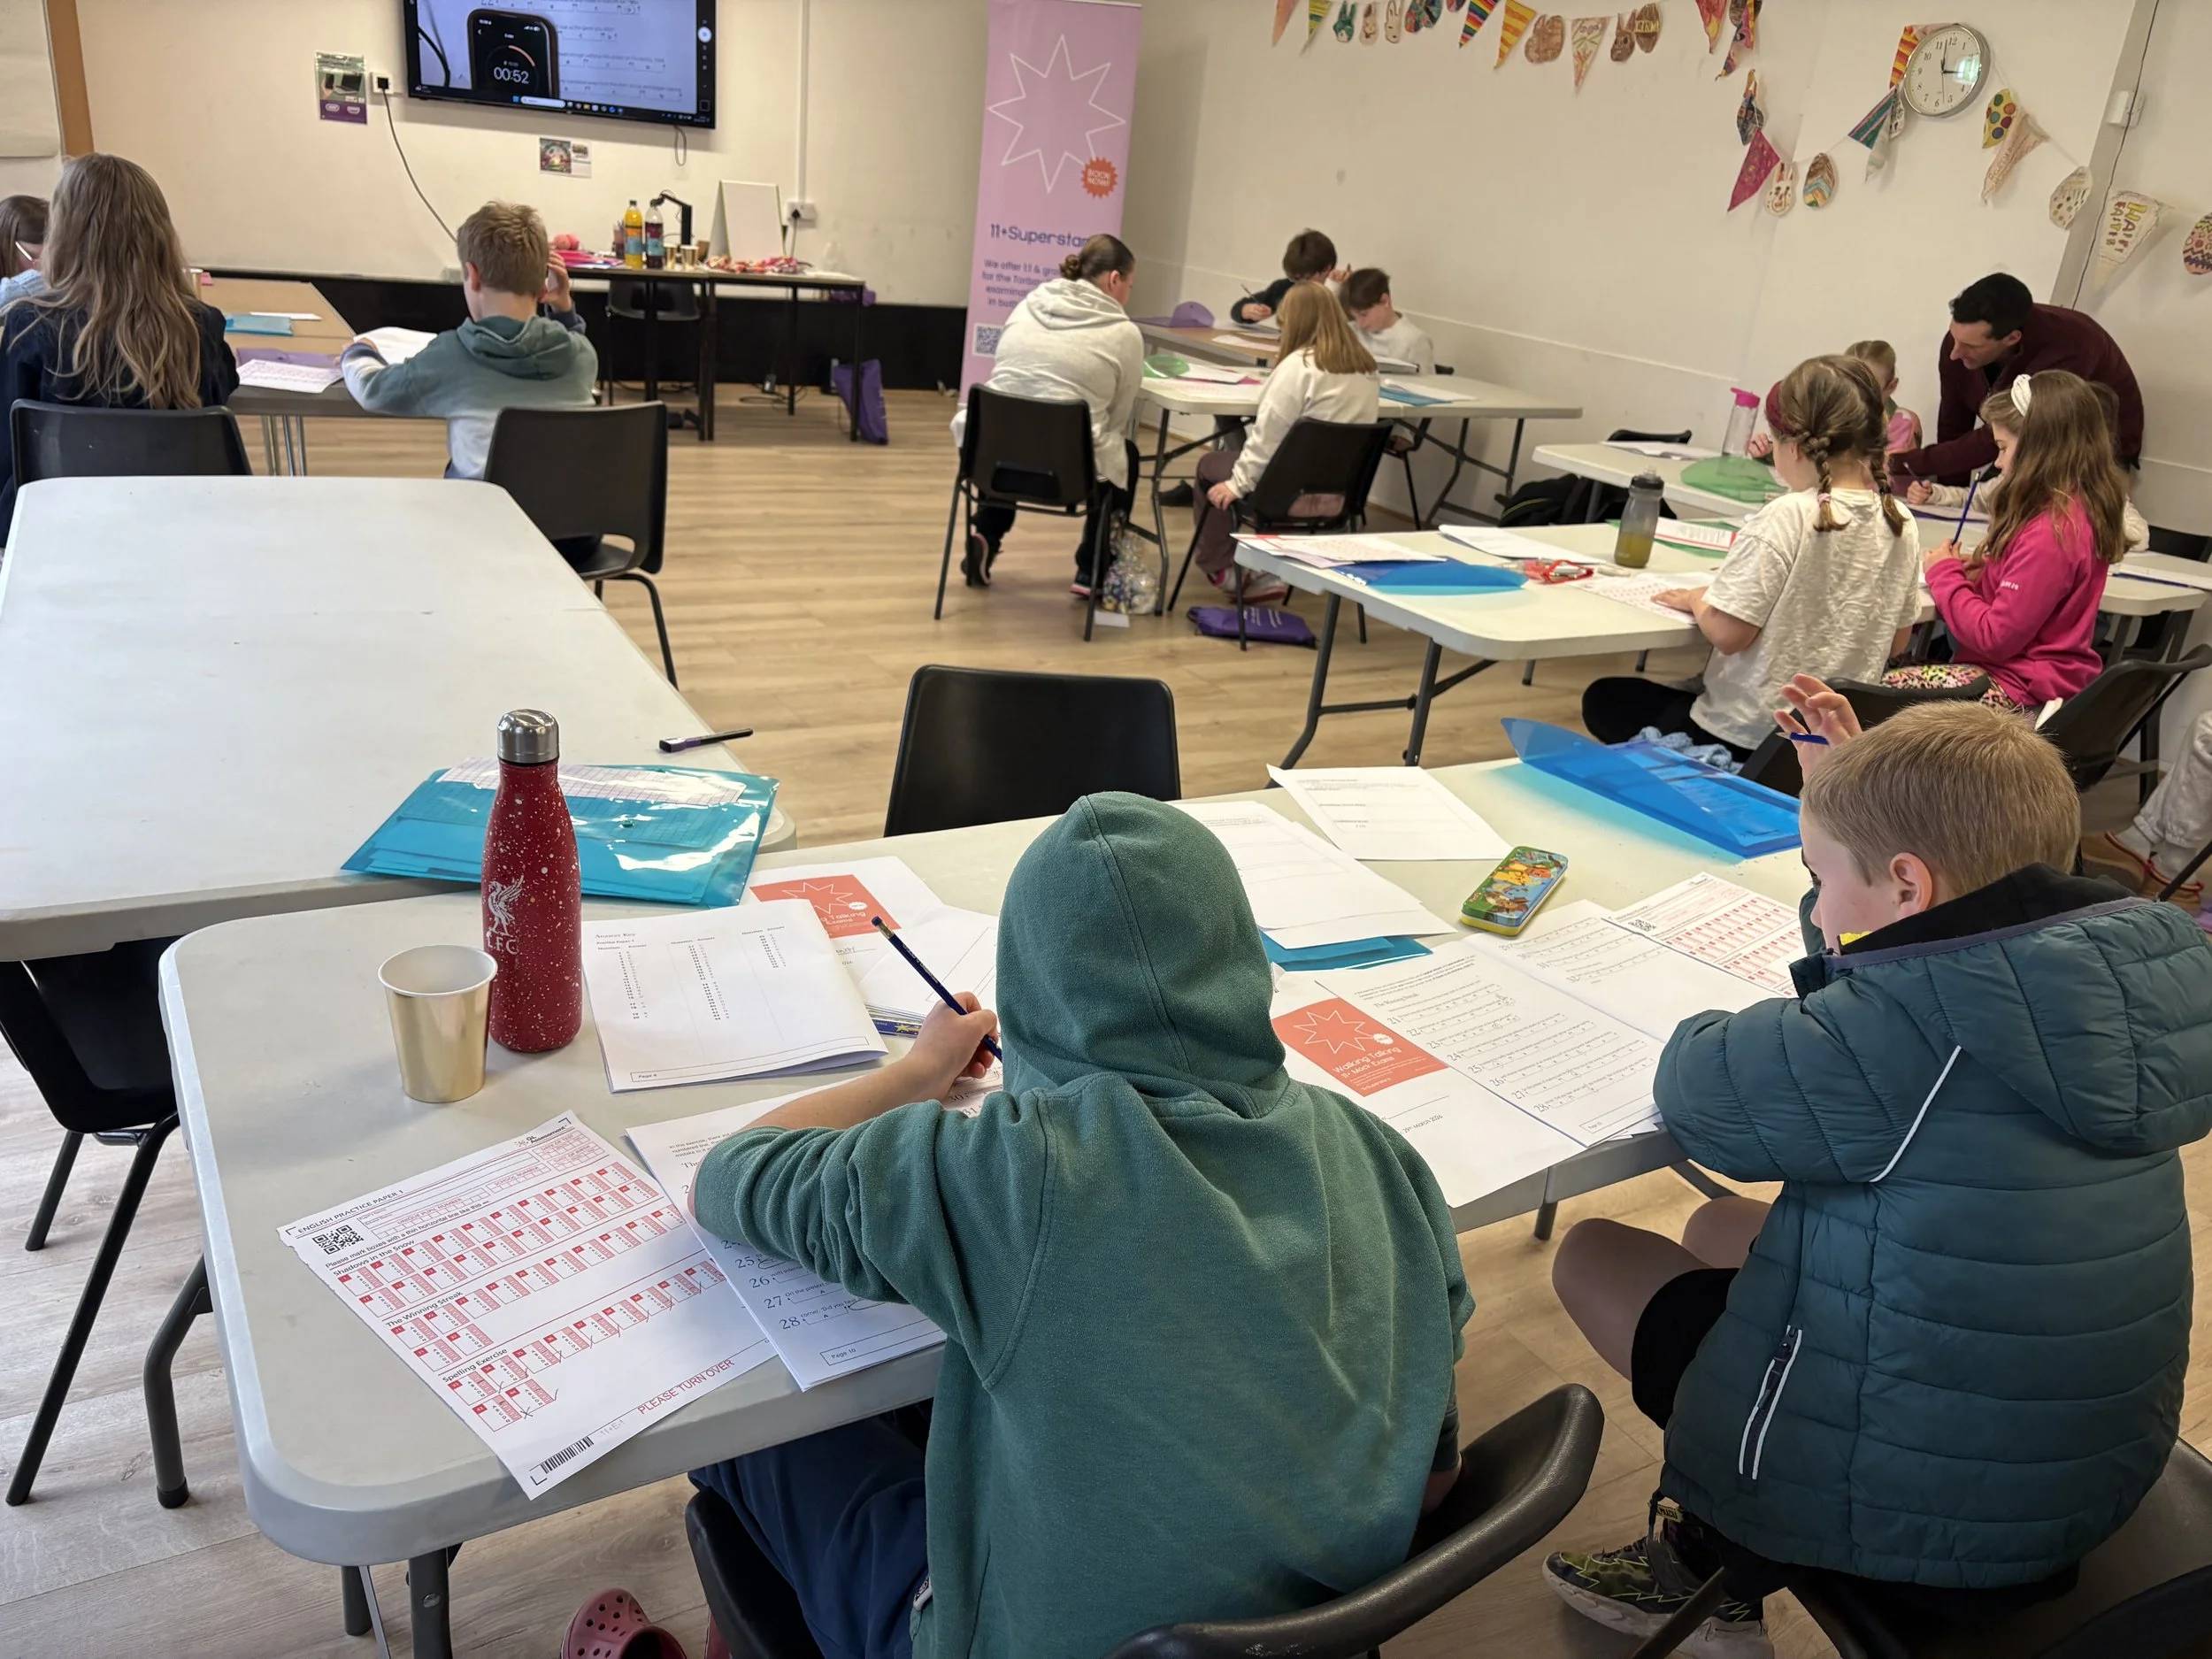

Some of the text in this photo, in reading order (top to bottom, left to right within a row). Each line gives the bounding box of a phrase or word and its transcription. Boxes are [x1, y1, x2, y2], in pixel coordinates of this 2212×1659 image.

[1935, 41, 1943, 50] 11
[1948, 36, 1958, 46] 12
[1962, 42, 1966, 50] 1
[1924, 52, 1932, 61] 10
[494, 66, 530, 84] 00:52
[1947, 95, 1953, 104] 5
[995, 272, 1011, 282] the
[486, 931, 519, 955] LFC
[1406, 1028, 1421, 1037] 22
[1426, 1040, 1440, 1049] 23
[1332, 1056, 1371, 1073] Walking
[1367, 1047, 1402, 1059] Talking
[1447, 1052, 1461, 1062] 24
[1350, 1064, 1371, 1074] Mock
[1371, 1056, 1395, 1067] Exams
[1468, 1064, 1484, 1074] 25
[1489, 1077, 1504, 1087] 26
[1511, 1089, 1525, 1100] 27
[1533, 1102, 1549, 1113] 28
[297, 1217, 333, 1233] ENGLISH
[334, 1202, 373, 1219] PRACTICE
[373, 1192, 398, 1204] PAPER
[325, 1257, 349, 1269] Please
[349, 1248, 367, 1257] mark
[366, 1240, 387, 1251] boxes
[387, 1234, 401, 1244] with
[406, 1226, 418, 1235] thin
[418, 1214, 449, 1230] horizontal
[459, 1206, 471, 1215] like
[333, 1259, 370, 1276] Shadows
[379, 1248, 393, 1256] the
[392, 1240, 416, 1251] Snow
[734, 1256, 755, 1269] 25
[749, 1275, 770, 1288] 26
[764, 1295, 783, 1310] 27
[805, 1282, 825, 1292] pretext
[385, 1291, 464, 1327] The Winning Streak
[779, 1316, 801, 1330] 28
[831, 1350, 848, 1360] Page
[442, 1348, 508, 1383] Spelling Exercise
[637, 1358, 736, 1415] PLEASE TURN OVER
[600, 1418, 626, 1437] 11+E-1
